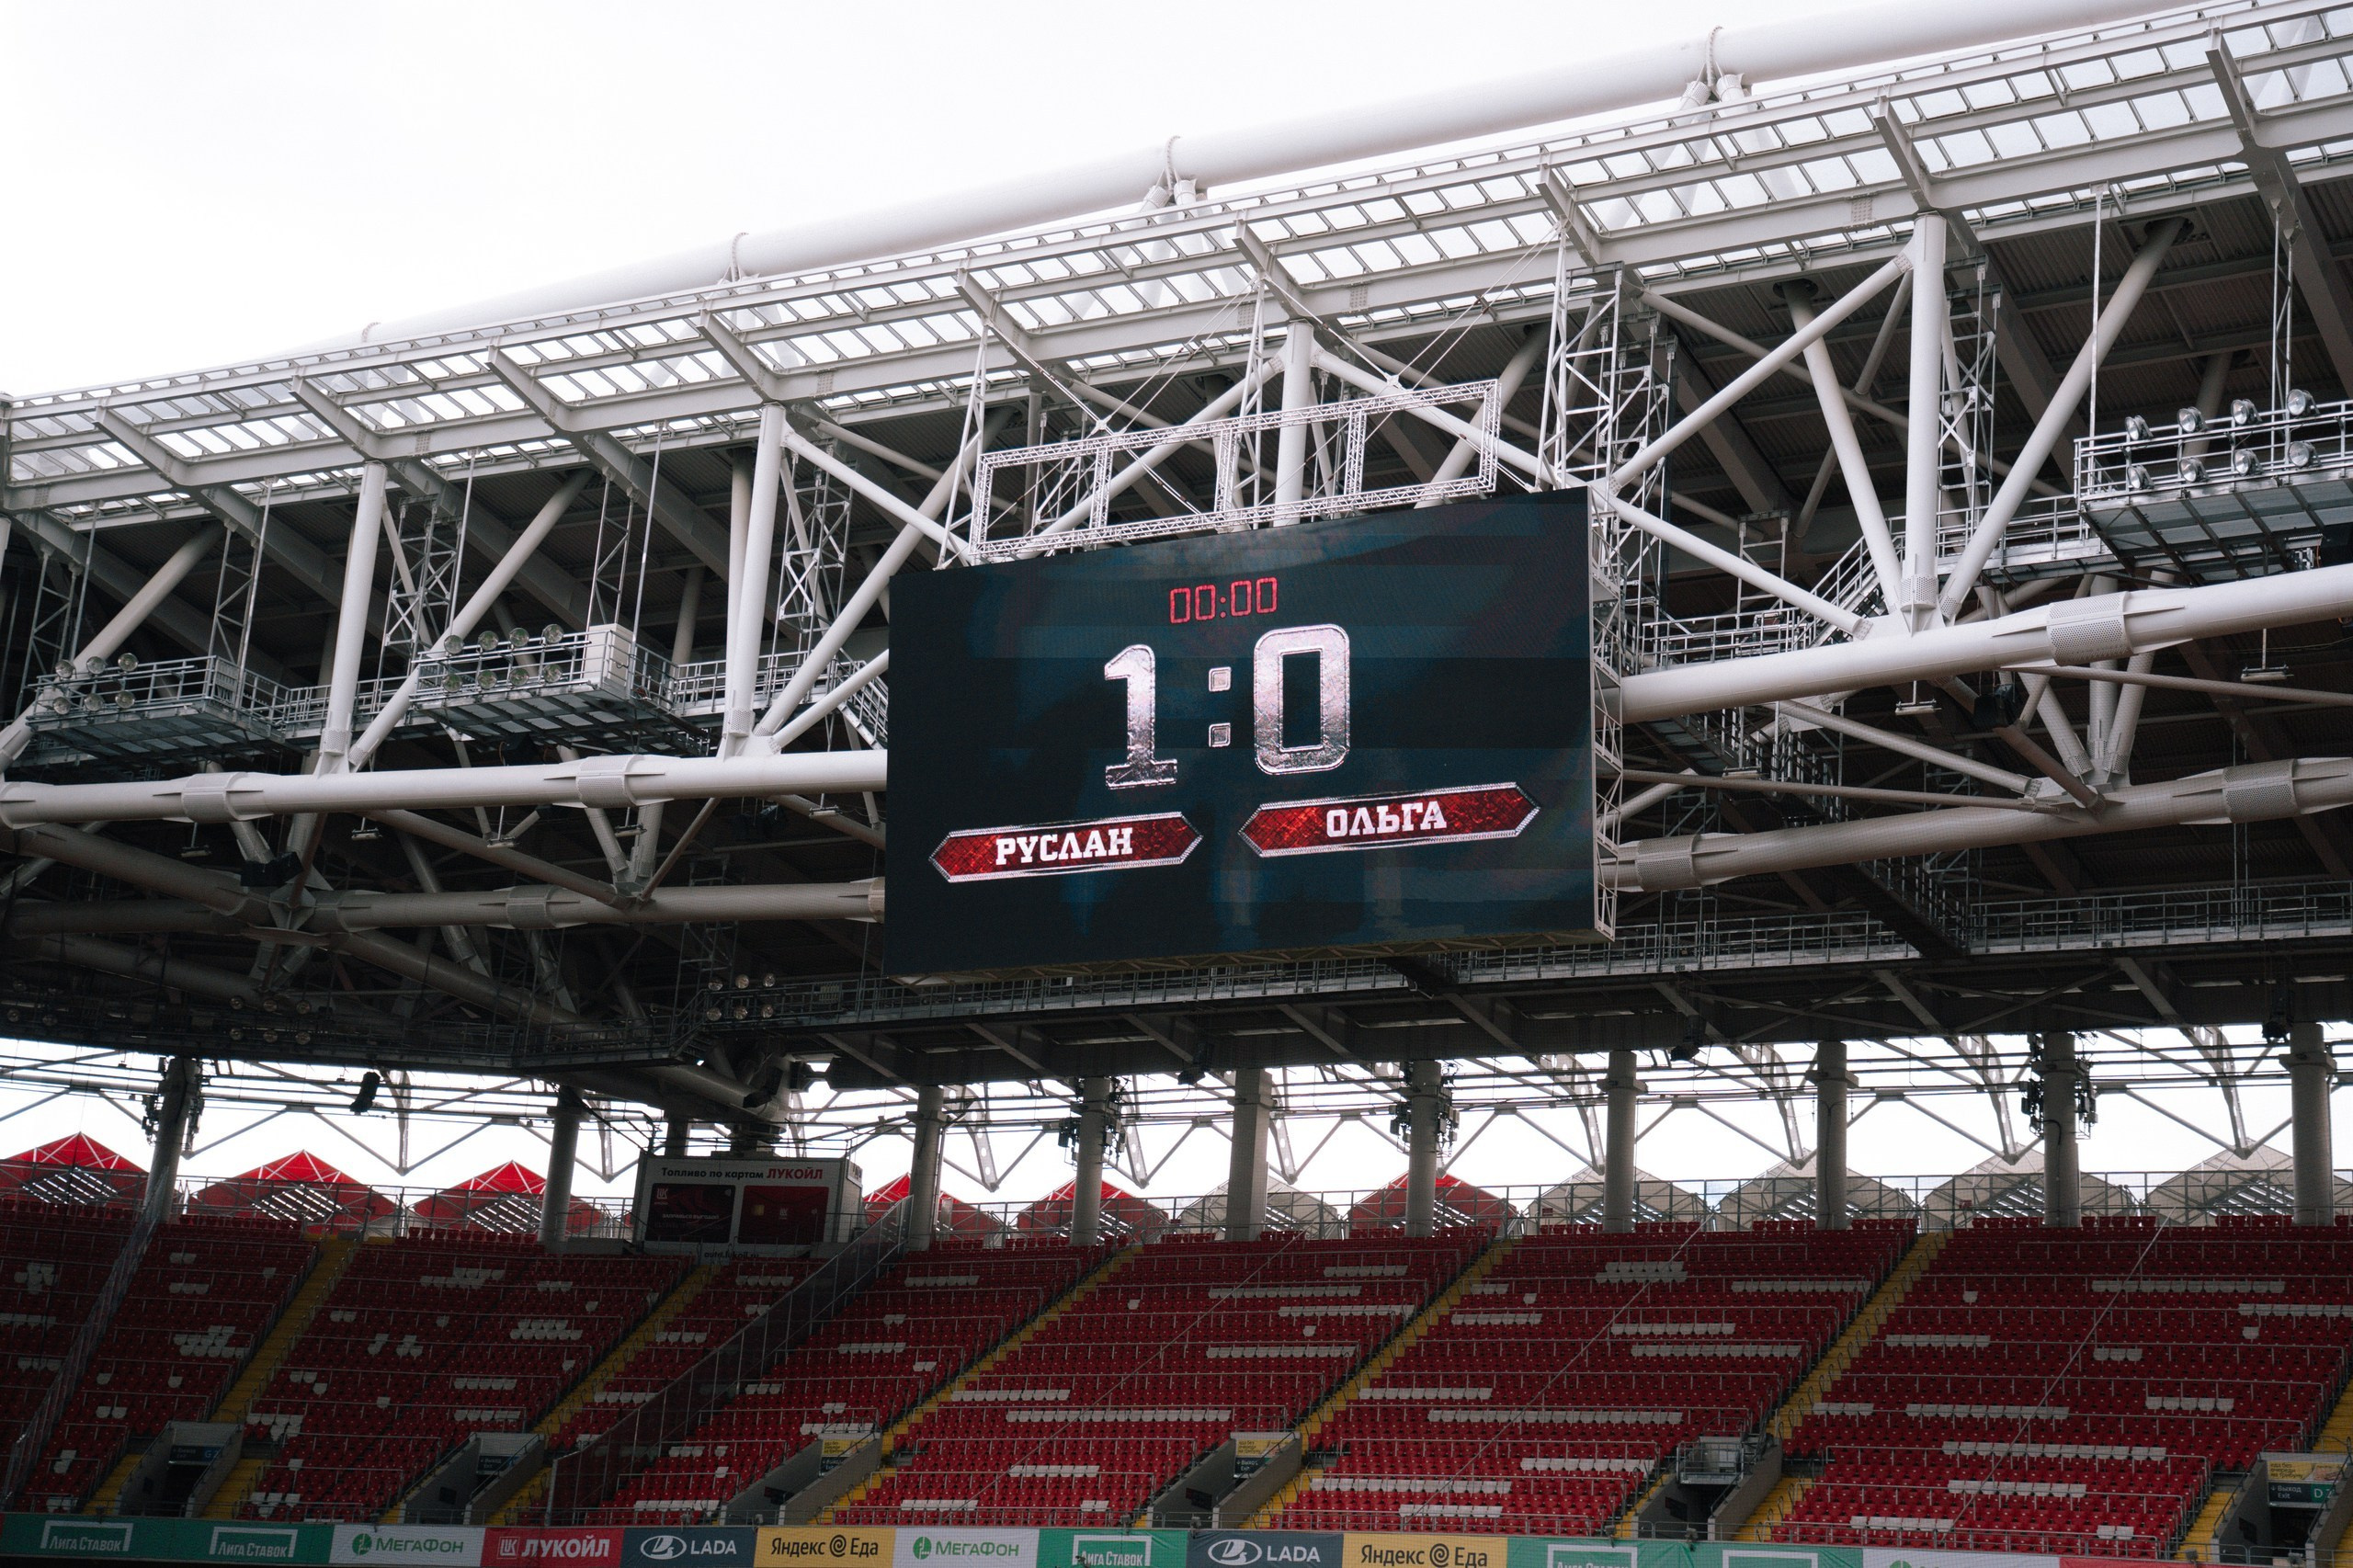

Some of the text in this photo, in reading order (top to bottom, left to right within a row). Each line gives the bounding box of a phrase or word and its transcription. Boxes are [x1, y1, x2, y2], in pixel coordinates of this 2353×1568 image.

[1169, 576, 1279, 624] 00:00
[1325, 801, 1448, 839] ОЛЬГА
[995, 827, 1133, 866] РУСЛАН
[662, 1166, 824, 1181] Топливо по картам ЛУКОЙЛ
[521, 1534, 610, 1558] ЛУКОЙЛ
[690, 1540, 737, 1555] LADA
[771, 1538, 879, 1558] Яндекс Еда
[1267, 1545, 1321, 1562] LADA
[1361, 1544, 1487, 1568] Яндекс Еда
